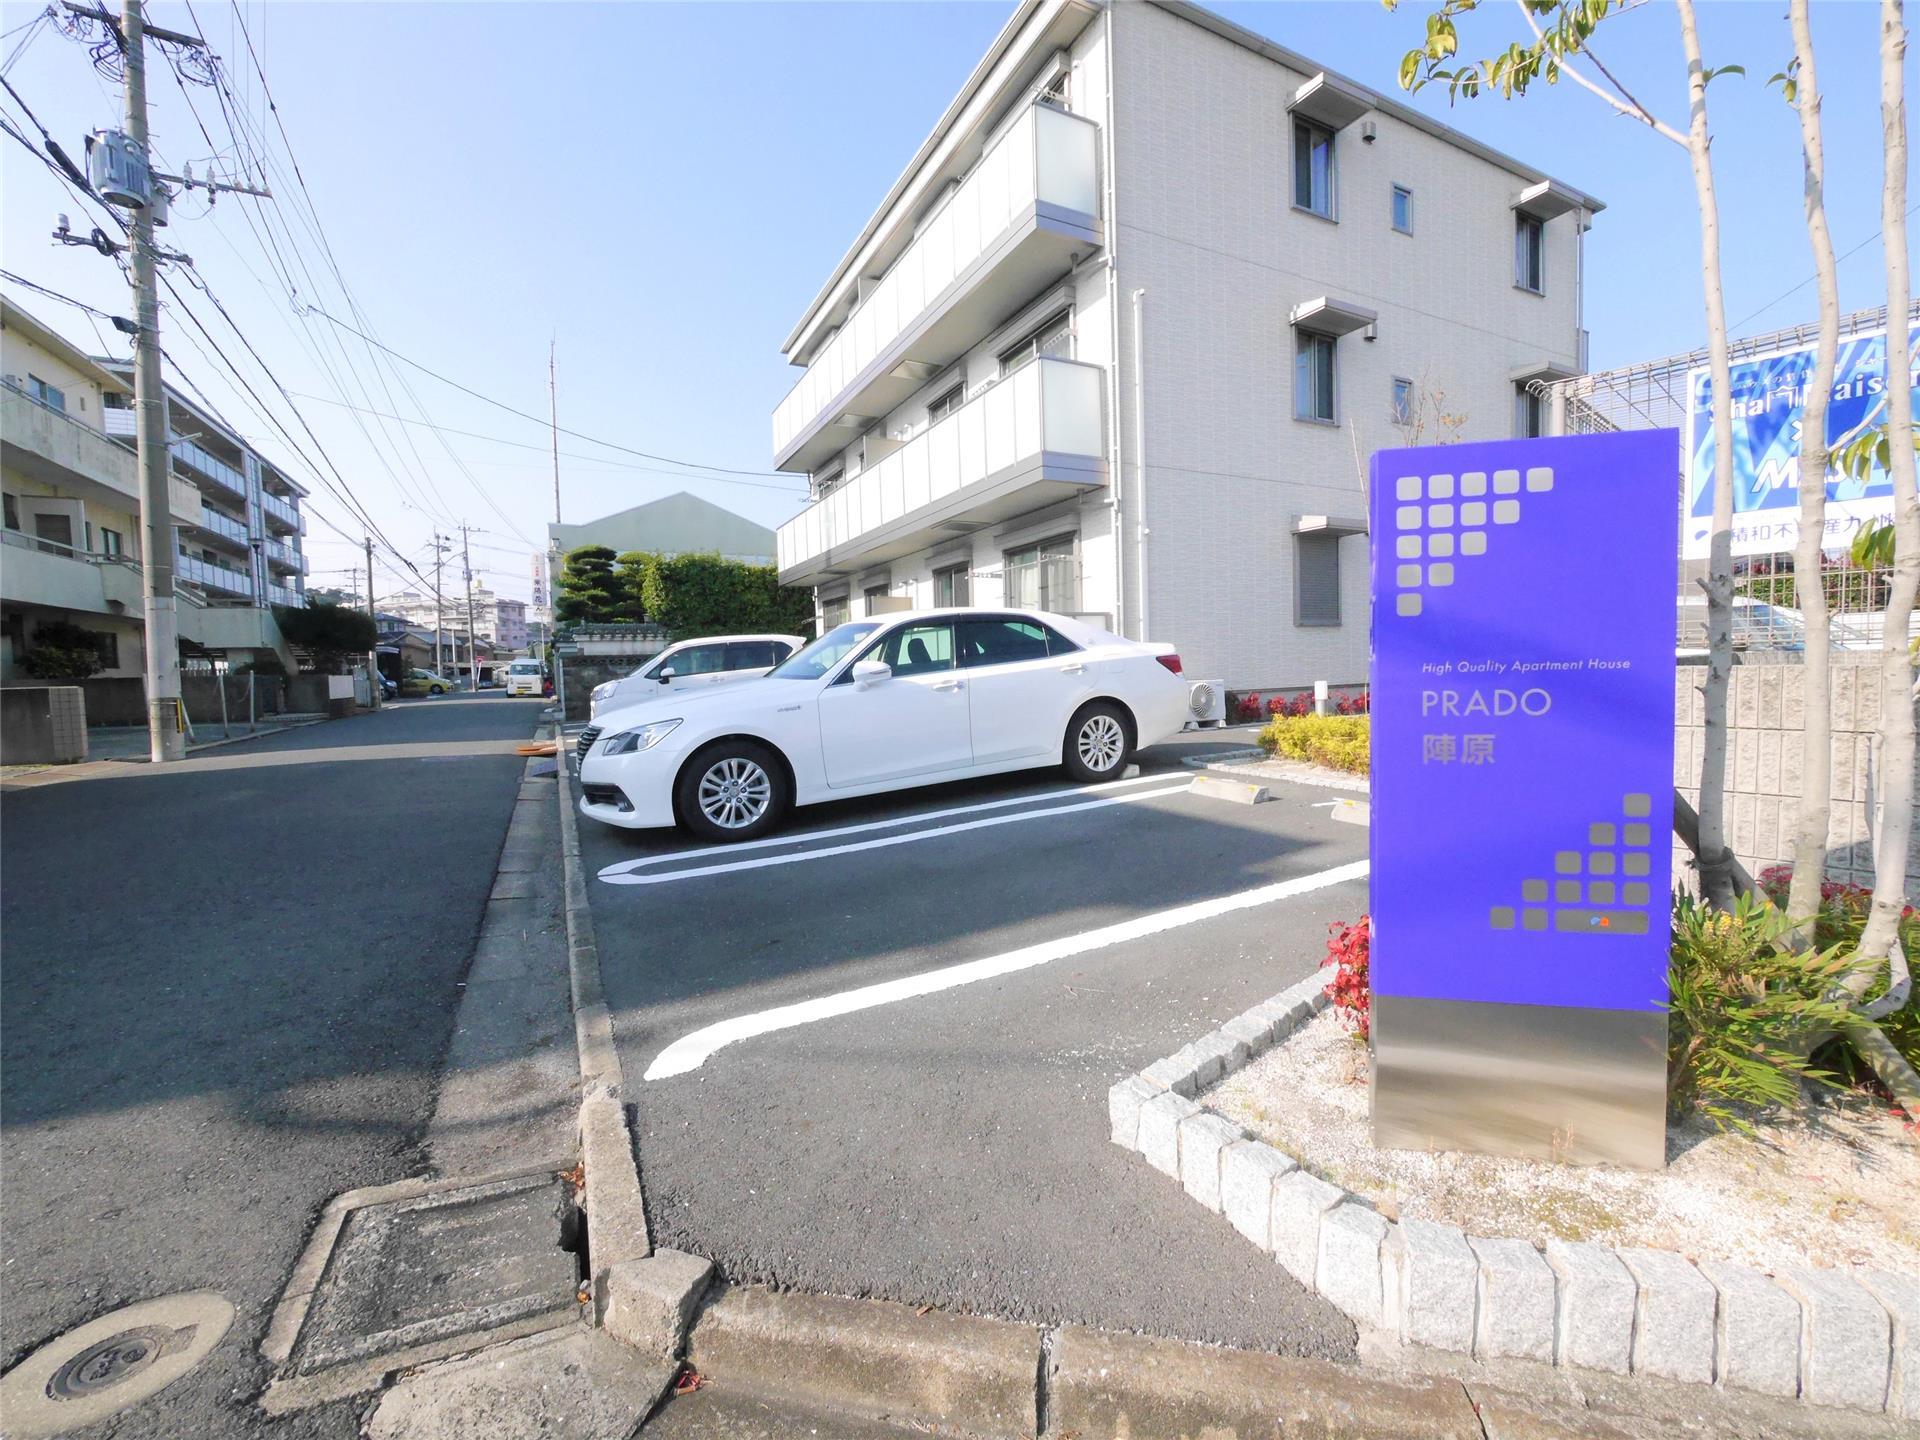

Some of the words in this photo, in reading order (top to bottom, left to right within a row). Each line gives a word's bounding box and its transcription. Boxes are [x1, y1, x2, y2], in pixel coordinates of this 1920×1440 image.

[1708, 396, 1764, 423] ha
[1422, 662, 1453, 676] High
[1457, 660, 1507, 675] Quality
[1511, 660, 1584, 674] Apartment
[1588, 658, 1631, 670] House
[1421, 687, 1552, 717] PRADO
[1422, 733, 1496, 765] 陣原
